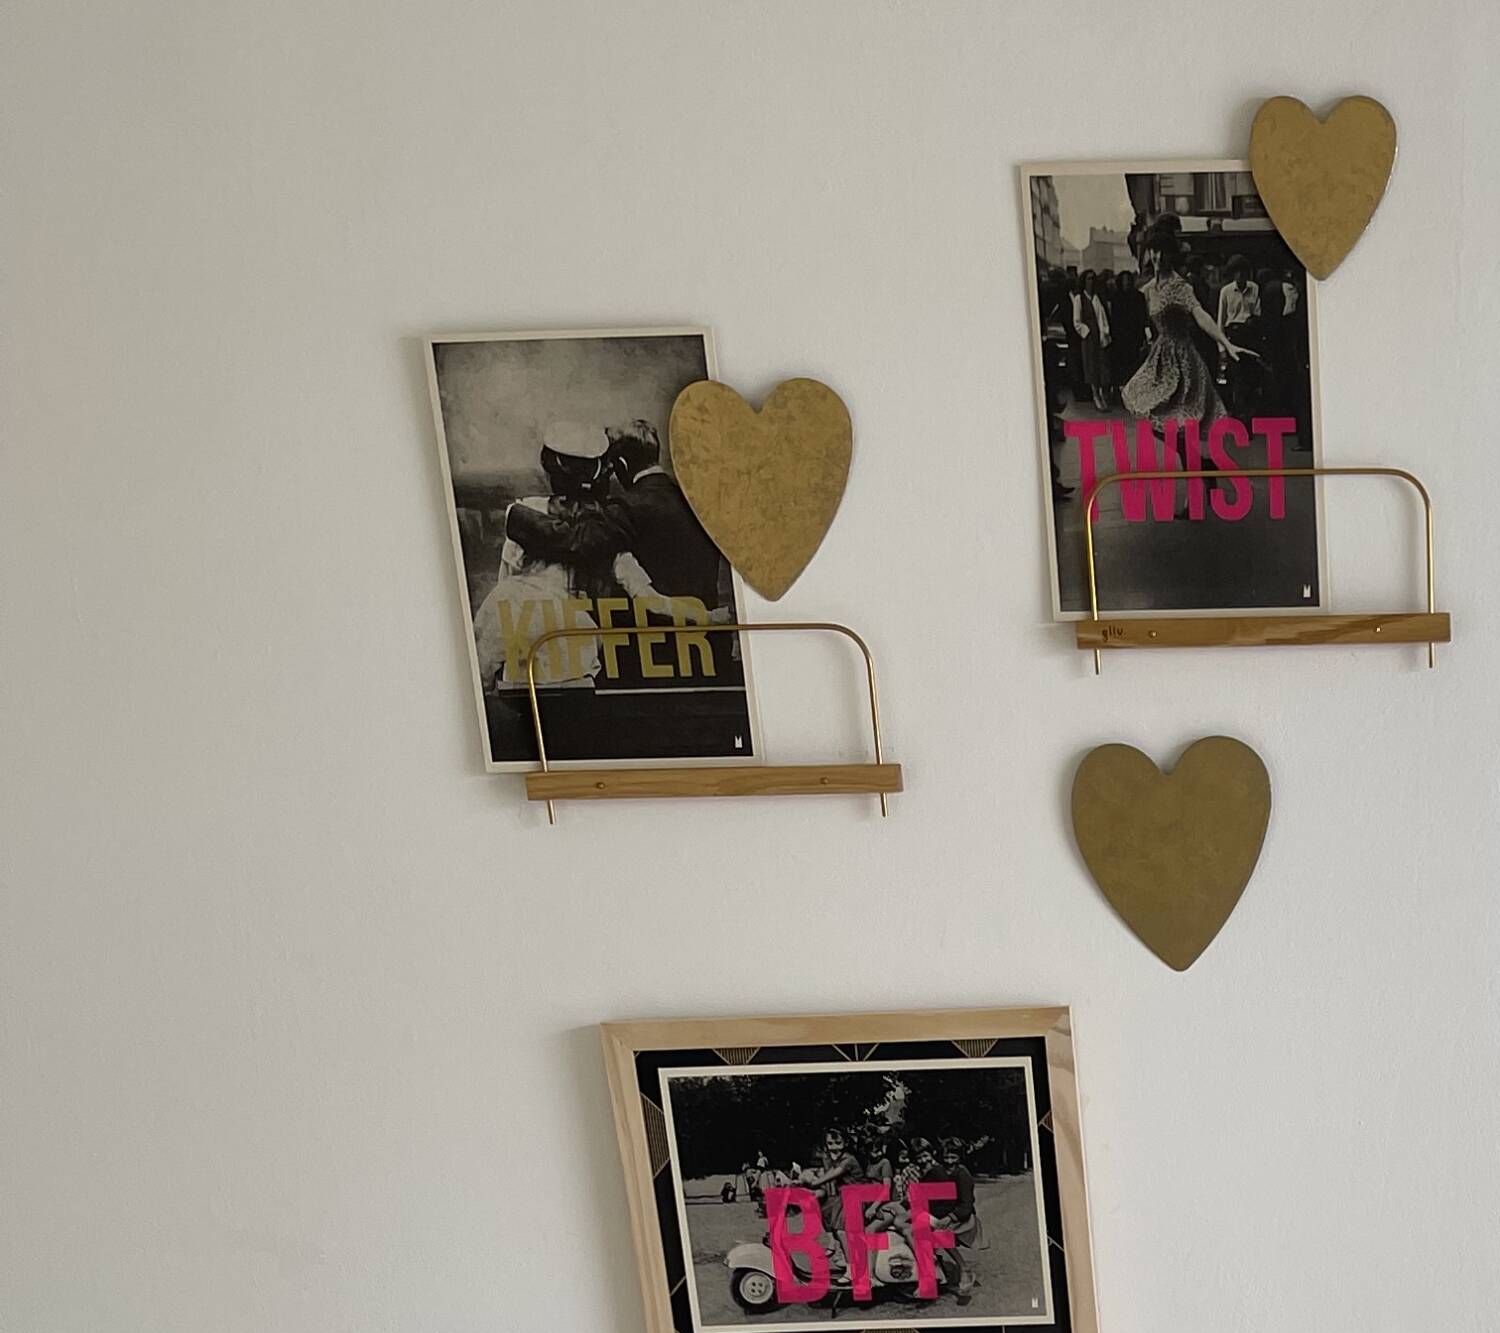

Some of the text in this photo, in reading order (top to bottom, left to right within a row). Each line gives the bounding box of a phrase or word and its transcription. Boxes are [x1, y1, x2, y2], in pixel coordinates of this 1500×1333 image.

[1063, 417, 1297, 522] TWIST
[497, 595, 717, 681] KIFFER
[764, 1182, 957, 1304] BFF
